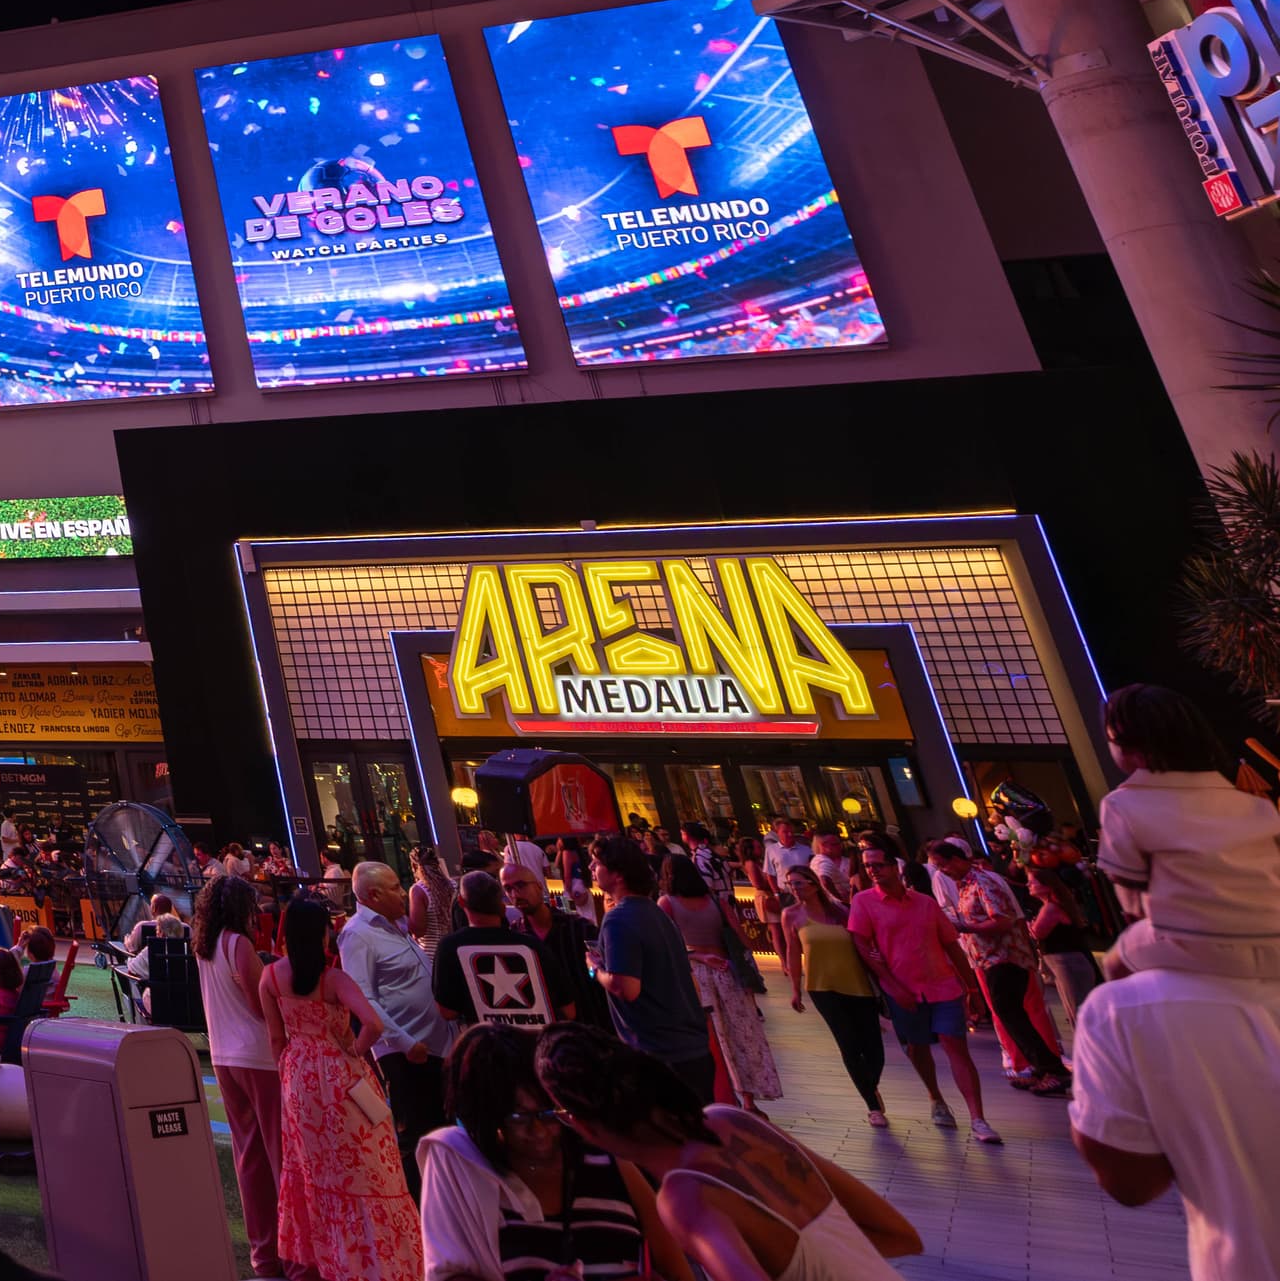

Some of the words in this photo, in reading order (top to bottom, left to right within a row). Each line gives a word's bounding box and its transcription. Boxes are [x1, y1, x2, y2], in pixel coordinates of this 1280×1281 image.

[1147, 41, 1220, 179] POPULAR
[252, 175, 444, 218] VERANO
[245, 214, 303, 244] DE
[308, 195, 465, 237] GOLES
[602, 198, 770, 231] TELEMUNDO
[271, 244, 345, 262] WATCH
[354, 232, 448, 254] PARTIES
[616, 223, 710, 251] PUERTO
[714, 219, 770, 242] RICO
[16, 262, 144, 290] TELEMUNDO
[25, 285, 93, 308] PUERTO
[99, 280, 143, 301] RICO
[34, 520, 61, 539] EN
[451, 556, 877, 717] ARENA
[47, 674, 89, 686] ADRIANA
[18, 691, 57, 703] ALOMAR
[561, 676, 751, 716] MEDALLA
[90, 708, 126, 719] YADIER
[40, 725, 81, 733] FRANCISCO
[1, 772, 46, 784] BETMGM
[155, 1112, 180, 1124] WASTE
[157, 1122, 184, 1135] PLEASE
